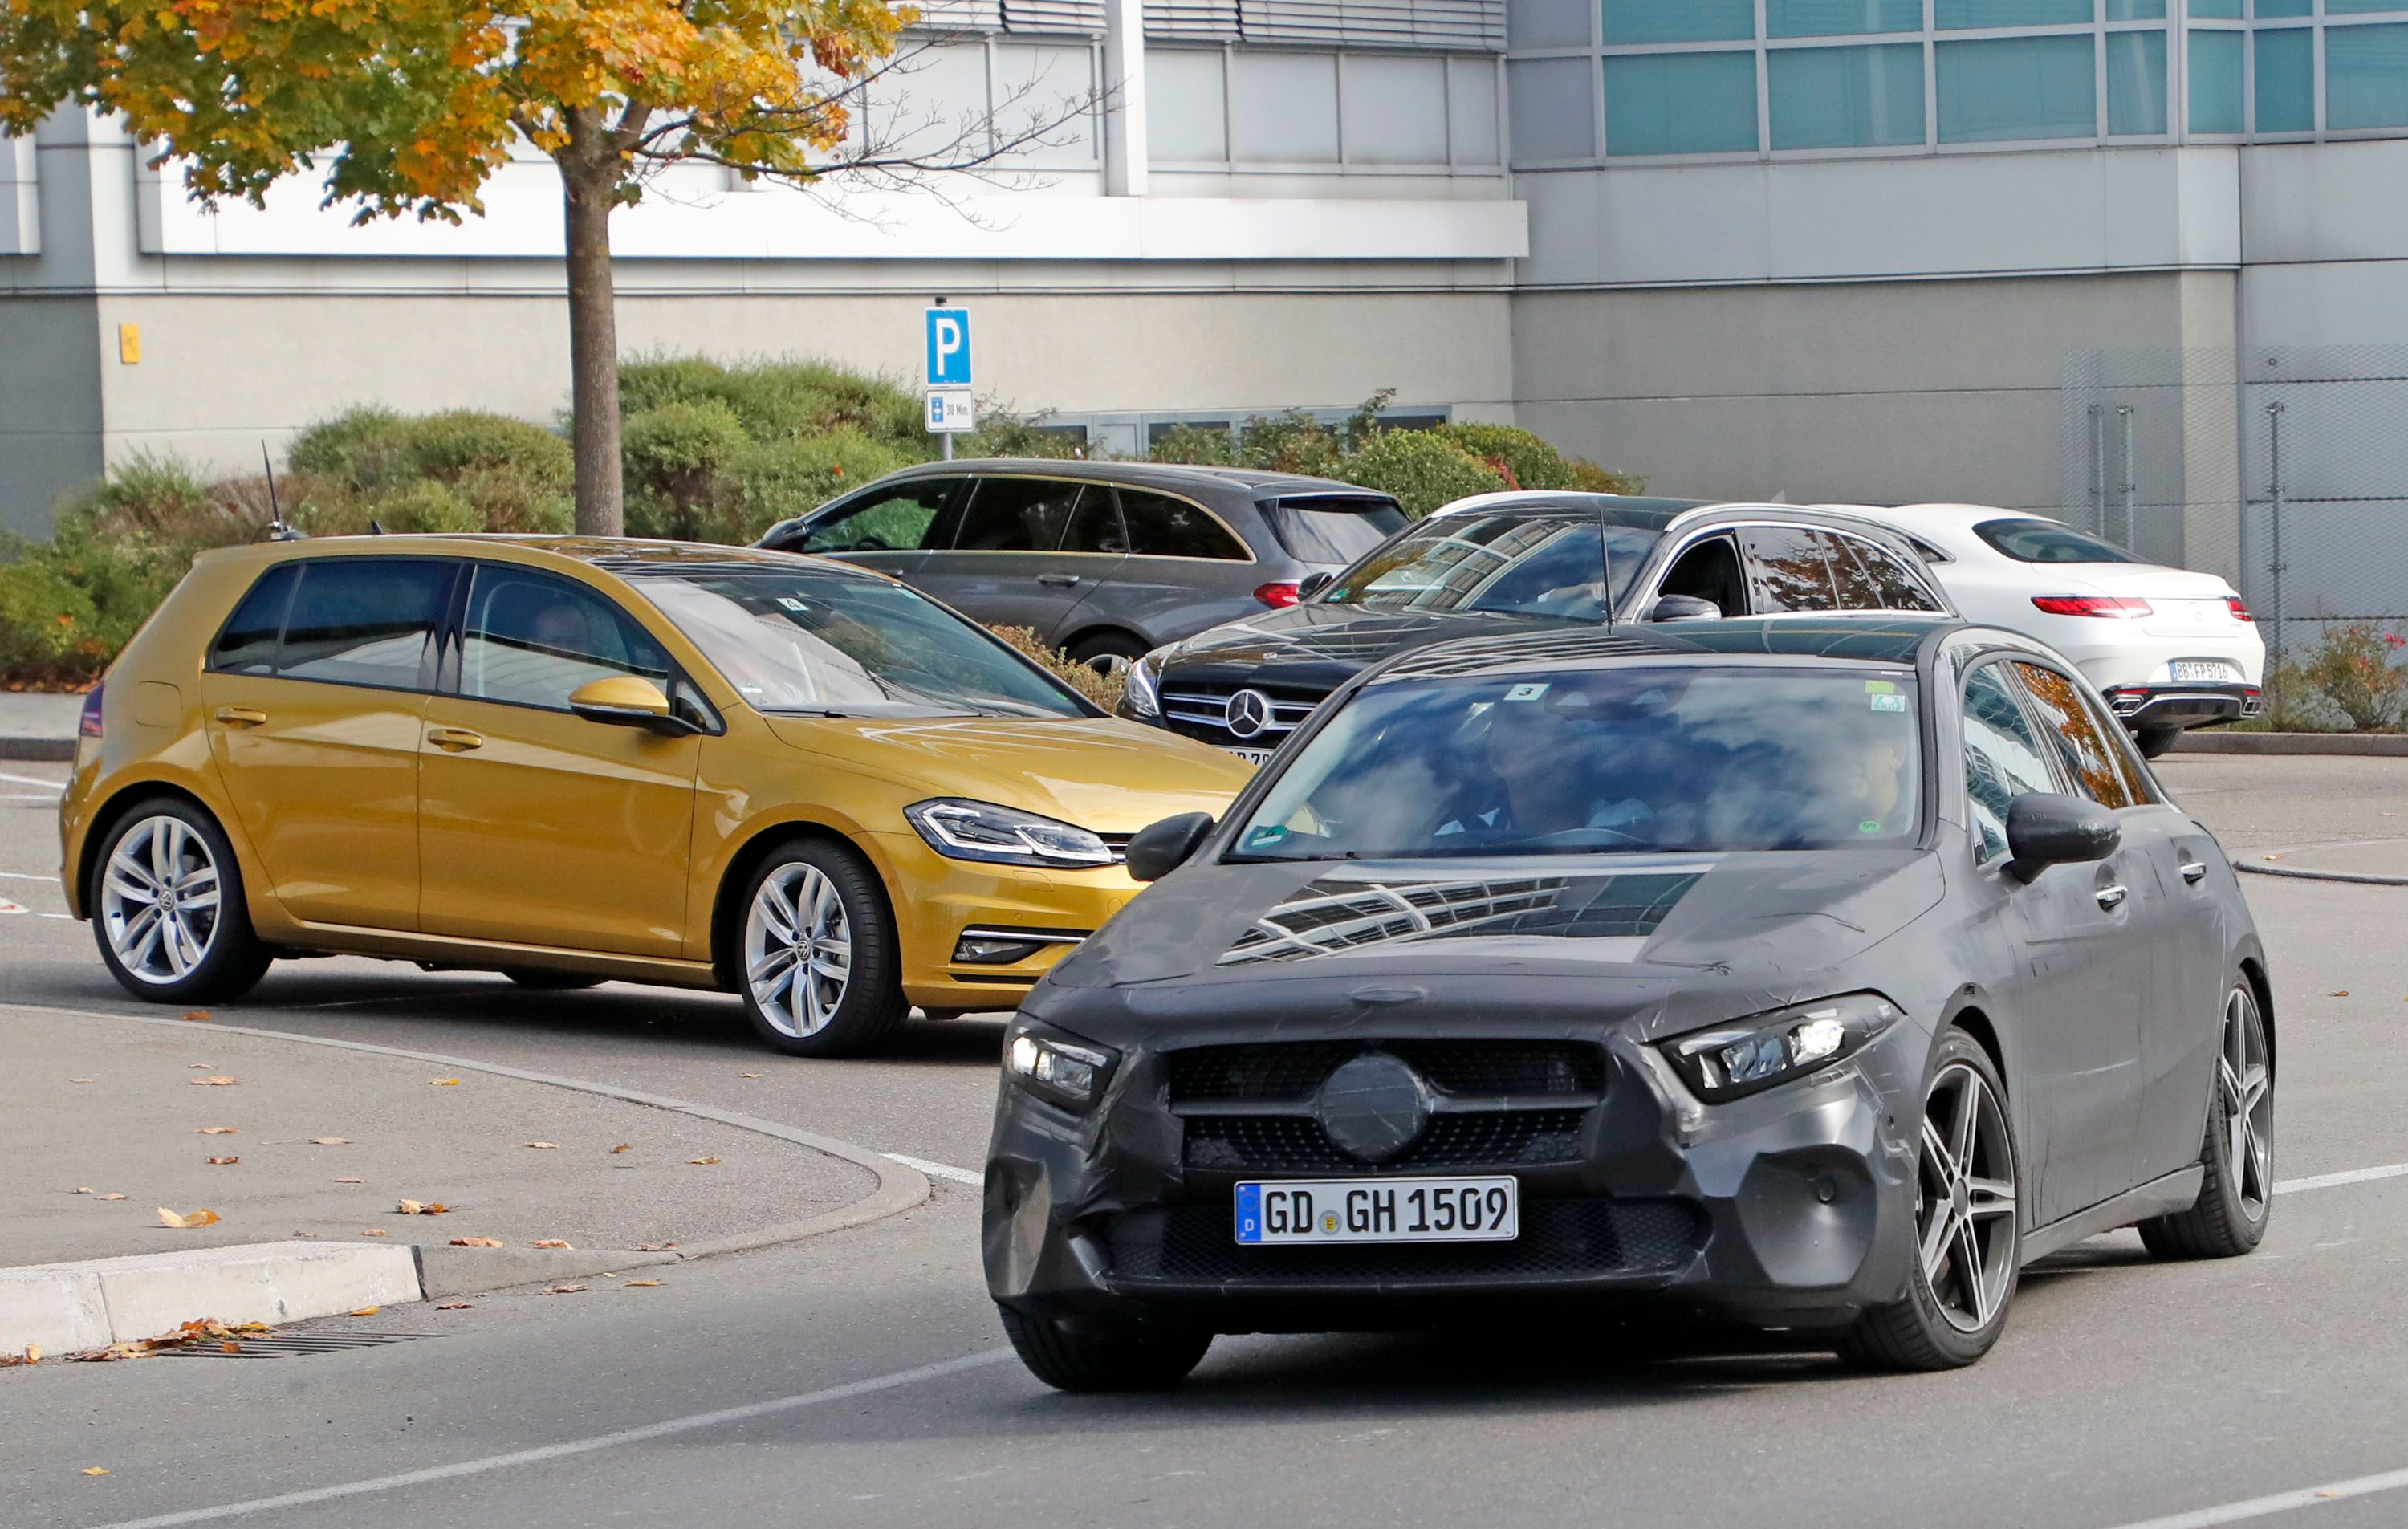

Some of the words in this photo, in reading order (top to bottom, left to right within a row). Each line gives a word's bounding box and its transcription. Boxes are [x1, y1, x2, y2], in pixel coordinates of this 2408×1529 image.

[936, 318, 961, 376] P
[946, 403, 954, 416] 30
[2177, 663, 2189, 678] BB
[2194, 663, 2206, 678] FP
[1518, 687, 1534, 697] 3
[1266, 1190, 1313, 1234] GD
[1346, 1189, 1397, 1233] GH
[1407, 1187, 1507, 1232] 1509
